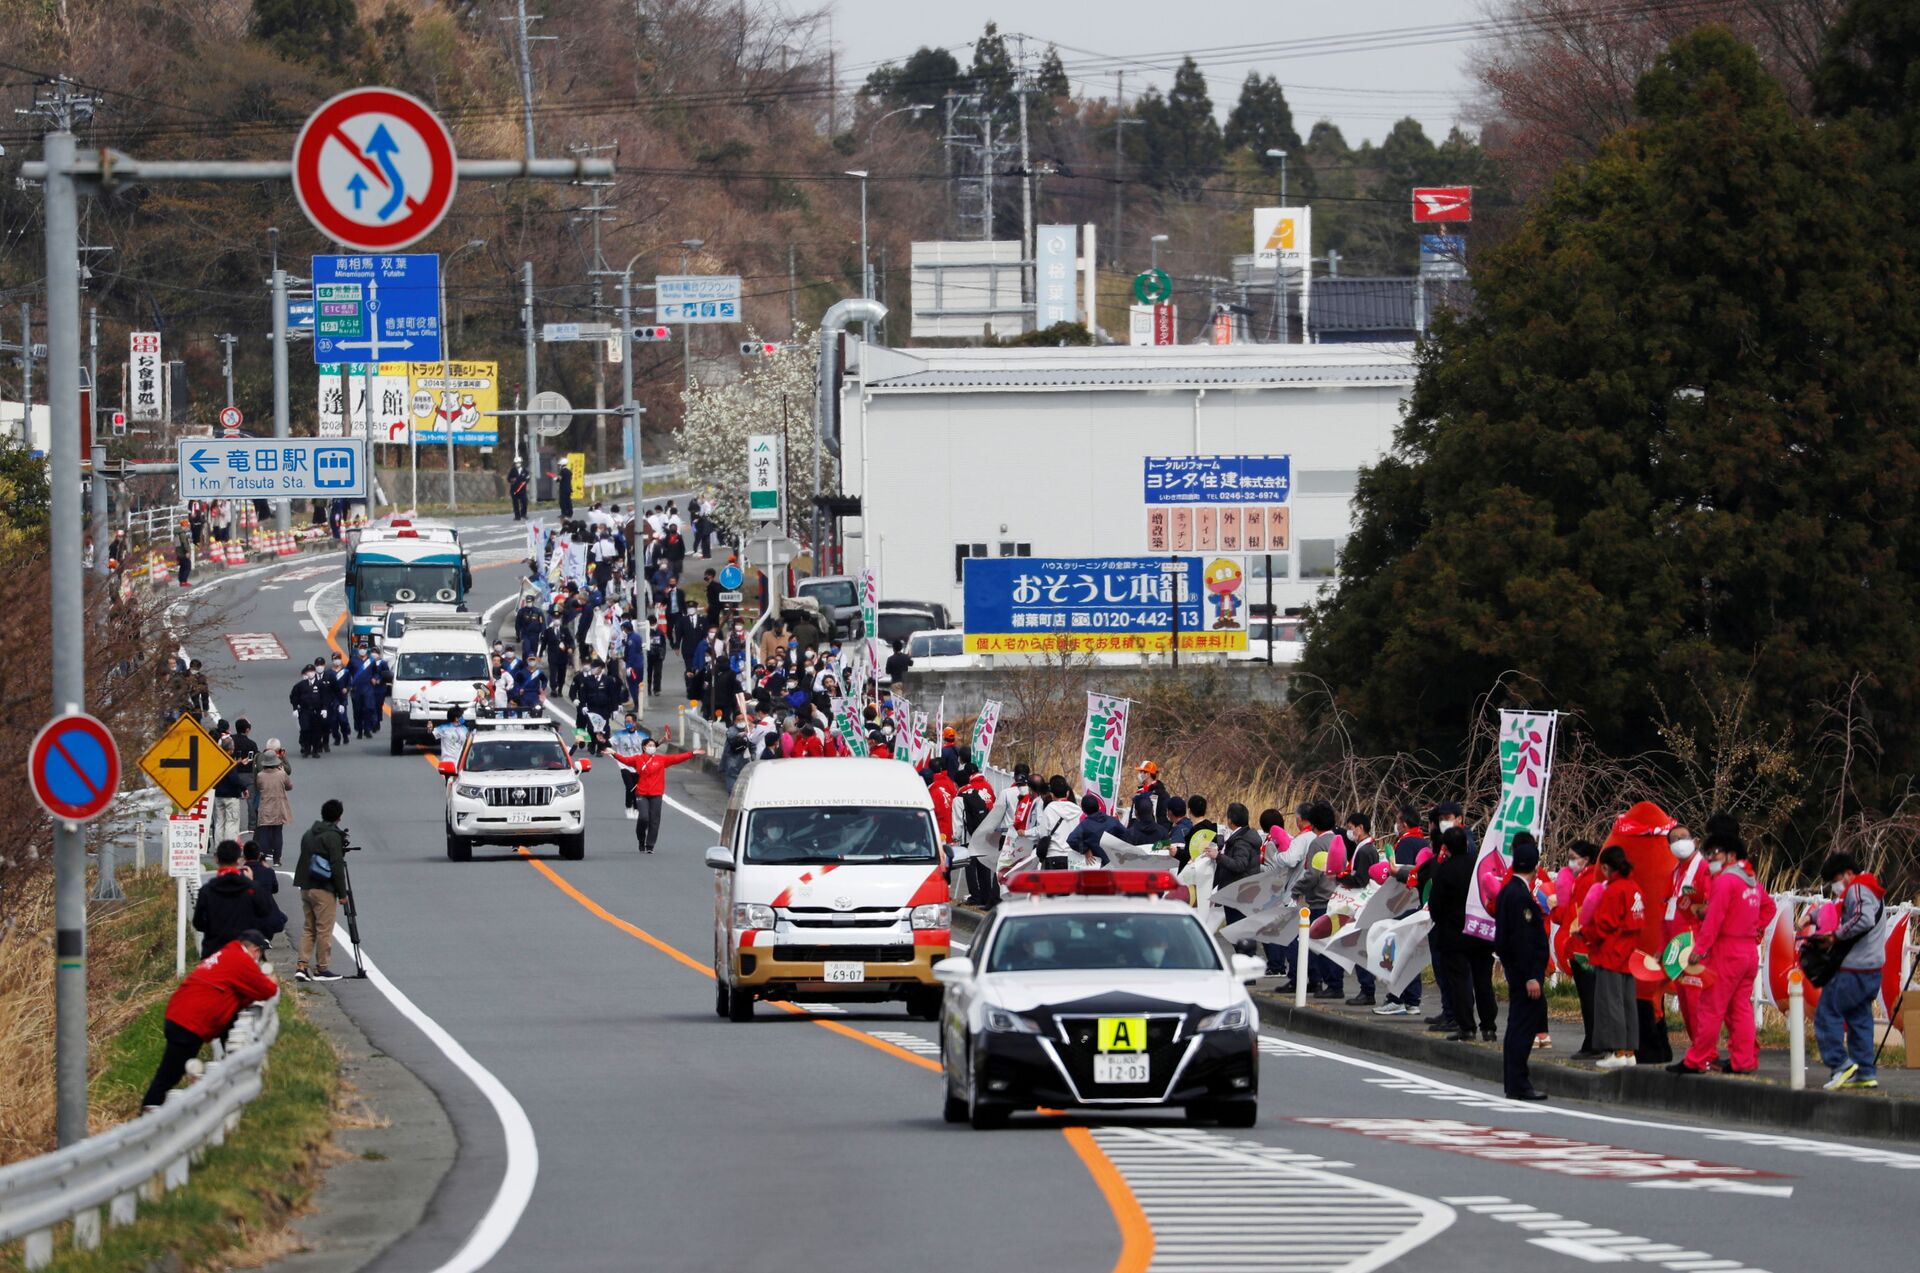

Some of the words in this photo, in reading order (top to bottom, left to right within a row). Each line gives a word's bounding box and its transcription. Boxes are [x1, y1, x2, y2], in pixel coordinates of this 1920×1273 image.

[336, 257, 374, 270] 南相馬
[381, 257, 407, 269] 双葉
[320, 288, 332, 296] E6
[1048, 262, 1065, 320] 楢葉町
[386, 317, 437, 329] 楢葉町役場
[138, 356, 156, 404] お食事処
[226, 448, 308, 472] 竜田駅
[1148, 461, 1220, 470] トータルリフォーム
[228, 476, 274, 489] Tatsuta
[282, 476, 305, 488] Sta.
[1220, 492, 1279, 500] 0246-32-6974
[1152, 513, 1163, 548] 増改築
[1177, 513, 1186, 549] キッチン
[1224, 512, 1235, 548] 外壁
[1248, 513, 1260, 548] 屋根
[1041, 561, 1161, 570] ハウスクリーニングの全国チェーン
[1012, 613, 1066, 627] 楢葉町店
[1093, 611, 1199, 627] 0120-442-13
[833, 970, 861, 981] 69-07
[1113, 1022, 1130, 1047] A
[1108, 1066, 1146, 1080] 12-03
